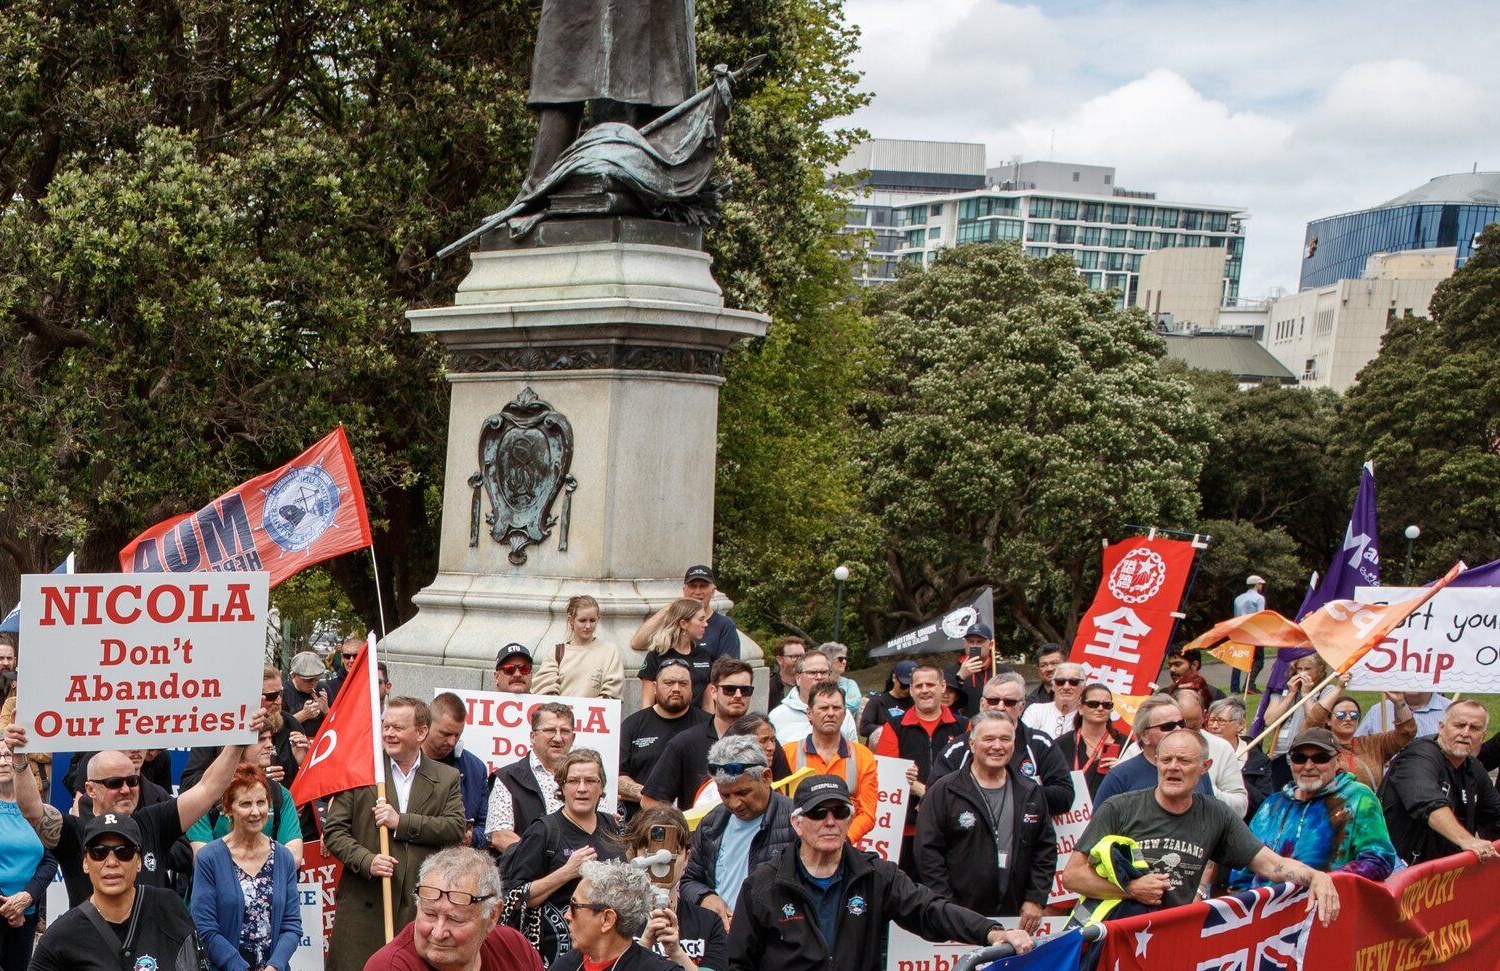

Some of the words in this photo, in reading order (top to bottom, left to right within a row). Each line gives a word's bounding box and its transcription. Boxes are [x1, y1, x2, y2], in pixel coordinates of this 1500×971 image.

[39, 584, 255, 626] NICOLA
[100, 637, 193, 666] Don't
[1364, 637, 1455, 685] Ship
[65, 672, 222, 703] Abandon
[33, 710, 105, 738] Our
[115, 704, 247, 736] Ferries!
[105, 813, 118, 825] R
[1135, 838, 1161, 850] NEW
[1163, 838, 1205, 859] ZEALAND
[1398, 866, 1465, 923] SUPPORT
